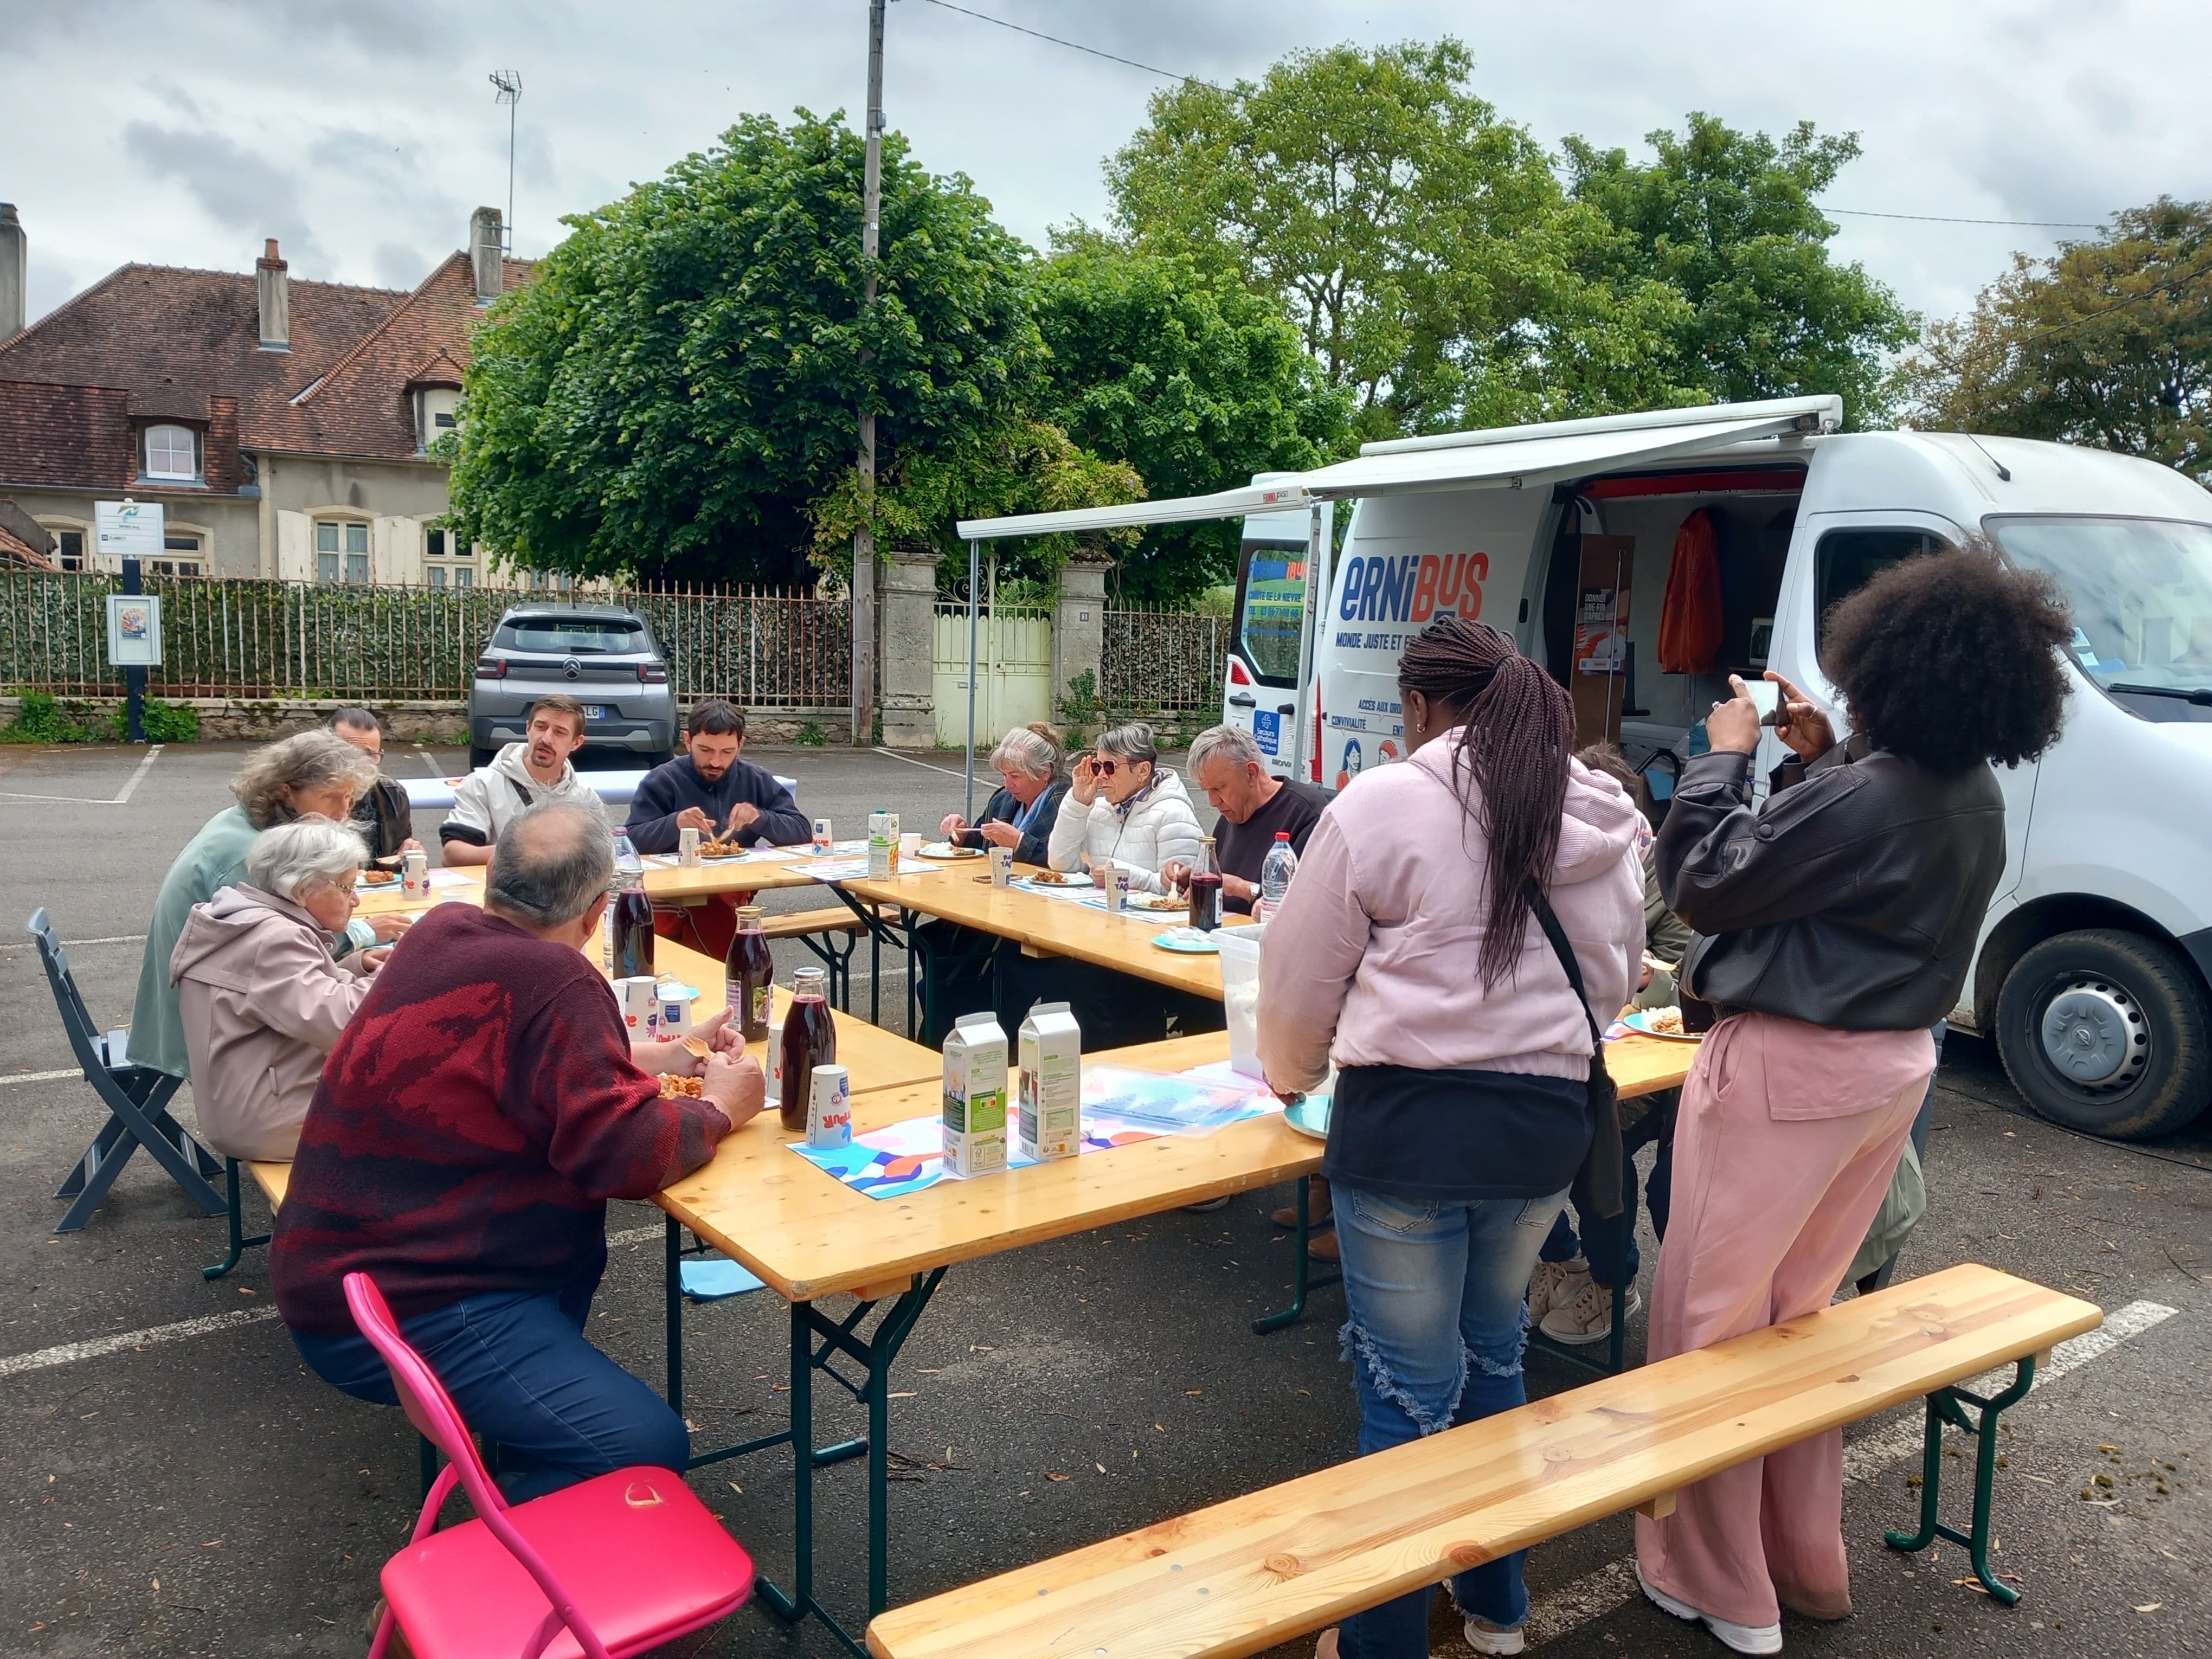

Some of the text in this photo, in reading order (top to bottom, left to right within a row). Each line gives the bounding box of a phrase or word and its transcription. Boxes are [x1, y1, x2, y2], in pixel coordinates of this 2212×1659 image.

[1335, 632, 1362, 648] MONDE
[1364, 633, 1390, 650] JUSTE
[1391, 634, 1403, 650] ET
[1358, 697, 1402, 715] ACCÈS AUX DROI
[1257, 728, 1275, 737] Secours
[1331, 716, 1404, 737] CONVIVIALITÉ ENT
[1254, 734, 1277, 744] Catholique
